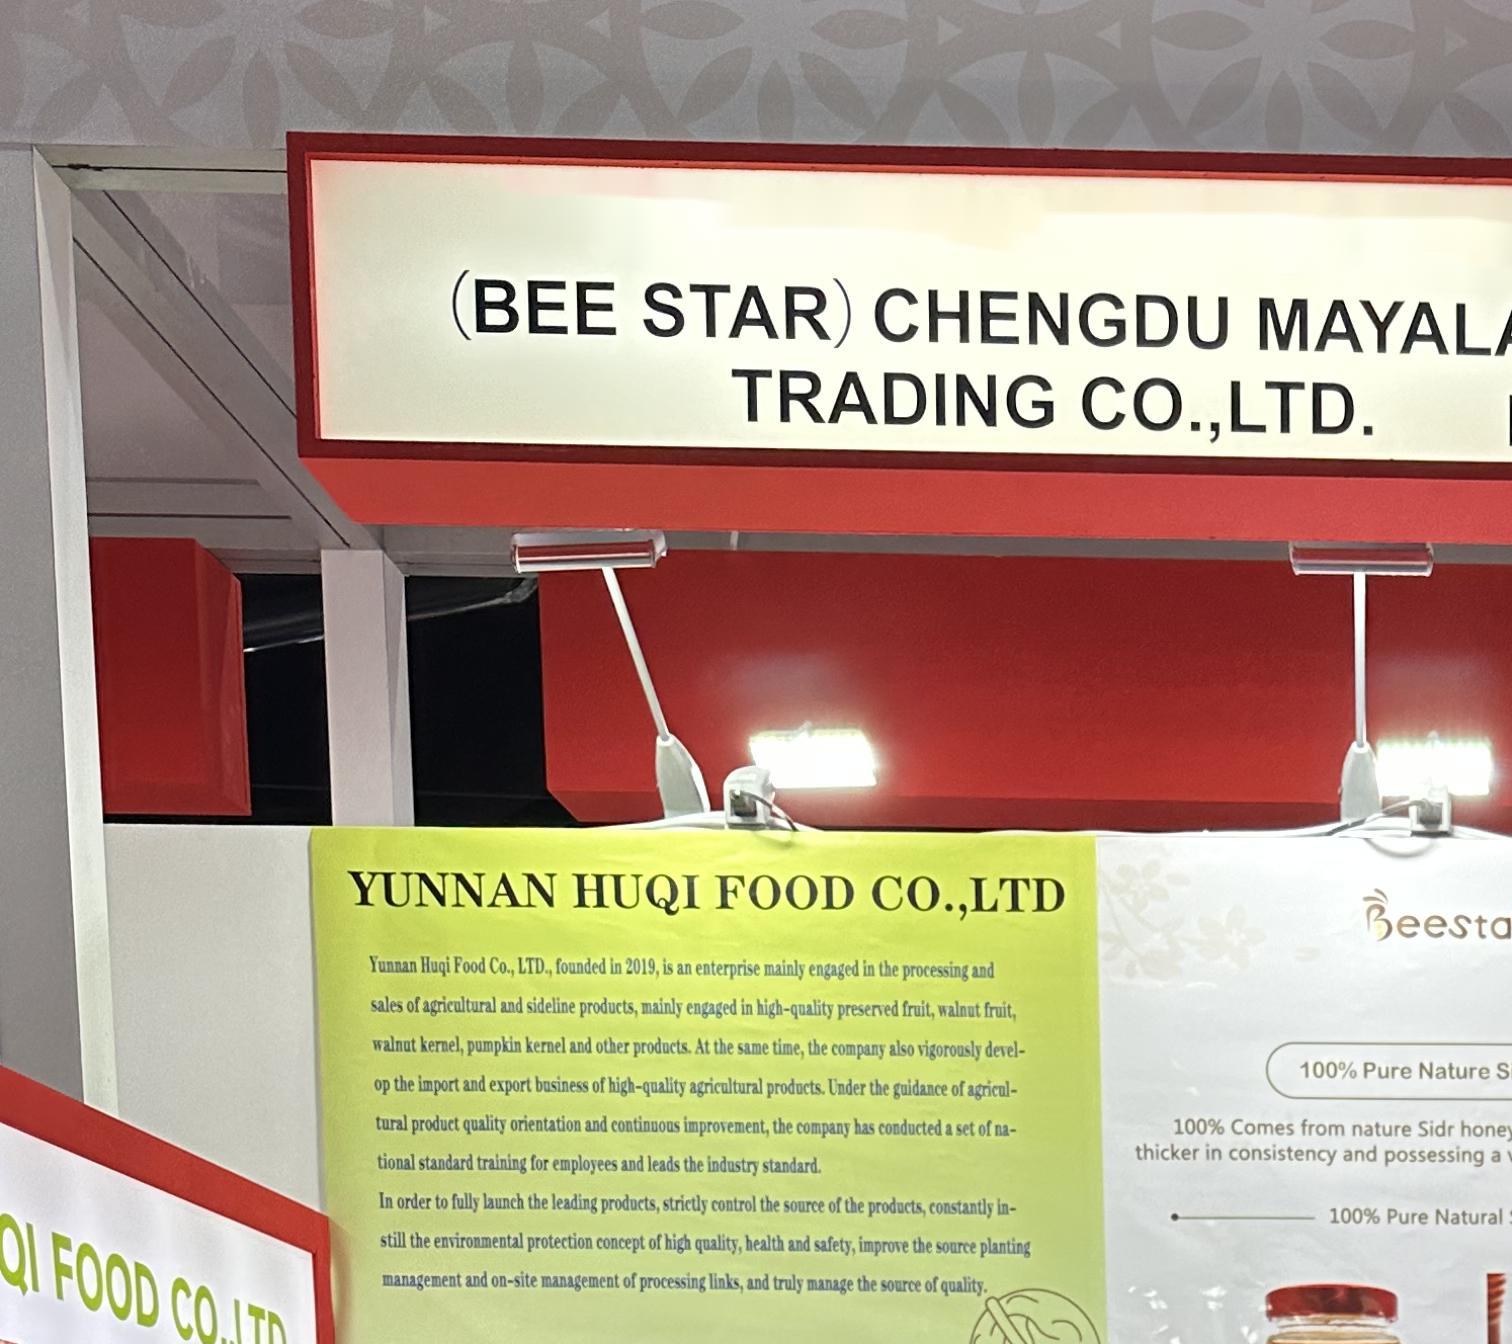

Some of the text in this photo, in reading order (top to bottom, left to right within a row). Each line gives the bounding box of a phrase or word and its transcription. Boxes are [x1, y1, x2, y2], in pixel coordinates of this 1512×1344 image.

[874, 287, 1229, 350] CHENGDU
[731, 368, 1374, 444] TRADING CO.,LTD.
[346, 870, 1066, 921] YUNNAN HUQI FOOD CO.,LTD
[368, 954, 418, 974] Yunnan
[419, 955, 452, 978] Huqi
[453, 955, 487, 975] Food
[555, 957, 607, 975] founded
[609, 956, 623, 975] in
[625, 957, 660, 978] 2019,
[662, 957, 674, 976] is
[676, 962, 693, 976] an
[695, 958, 761, 981] enterprise
[763, 959, 806, 982] mainly
[808, 959, 860, 981] engaged
[862, 959, 876, 978] in
[878, 959, 900, 978] the
[901, 960, 970, 983] processing
[970, 961, 995, 979] and
[1299, 1060, 1358, 1080] 100%
[1362, 1061, 1413, 1080] Pure
[1418, 1061, 1491, 1081] Nature
[1170, 1117, 1226, 1136] 100%
[1230, 1118, 1296, 1137] Comes
[1300, 1118, 1346, 1137] from
[1351, 1121, 1413, 1138] nature
[1417, 1119, 1456, 1138] Sidr
[1134, 1142, 1201, 1162] thicker
[1205, 1143, 1223, 1161] in
[1228, 1143, 1338, 1167] consistency
[1342, 1144, 1378, 1163] and
[1383, 1145, 1485, 1168] possessing
[1490, 1149, 1502, 1164] a
[1329, 1207, 1381, 1225] 100%
[1386, 1207, 1430, 1226] Pure
[1434, 1207, 1504, 1226] Natural
[51, 1231, 160, 1328] FOOD
